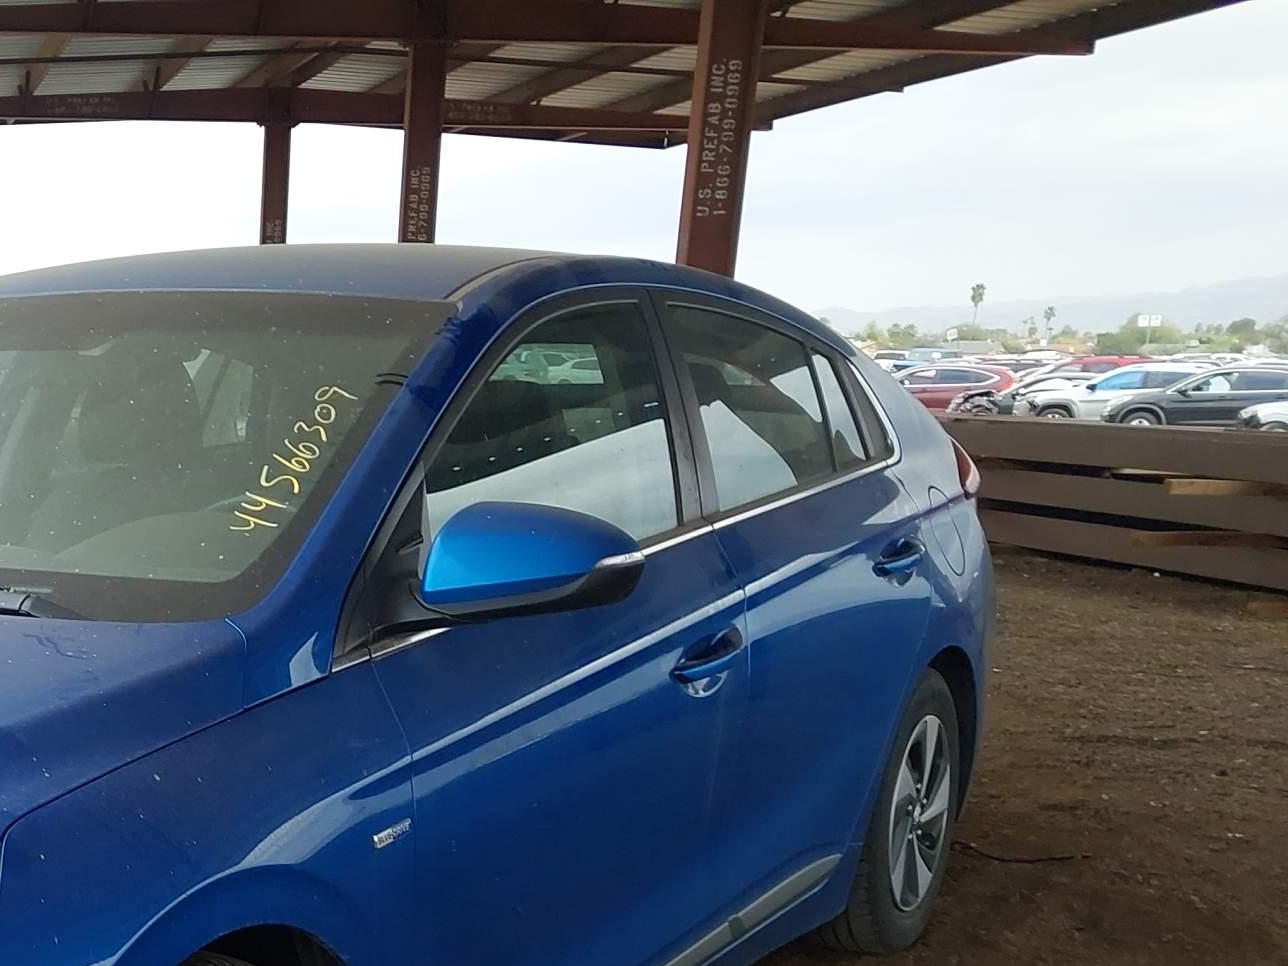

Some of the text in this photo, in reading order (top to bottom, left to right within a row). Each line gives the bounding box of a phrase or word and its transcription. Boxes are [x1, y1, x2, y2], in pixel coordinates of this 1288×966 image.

[695, 58, 727, 217] U.S. PREFAB INC.
[229, 385, 359, 530] 44566309
